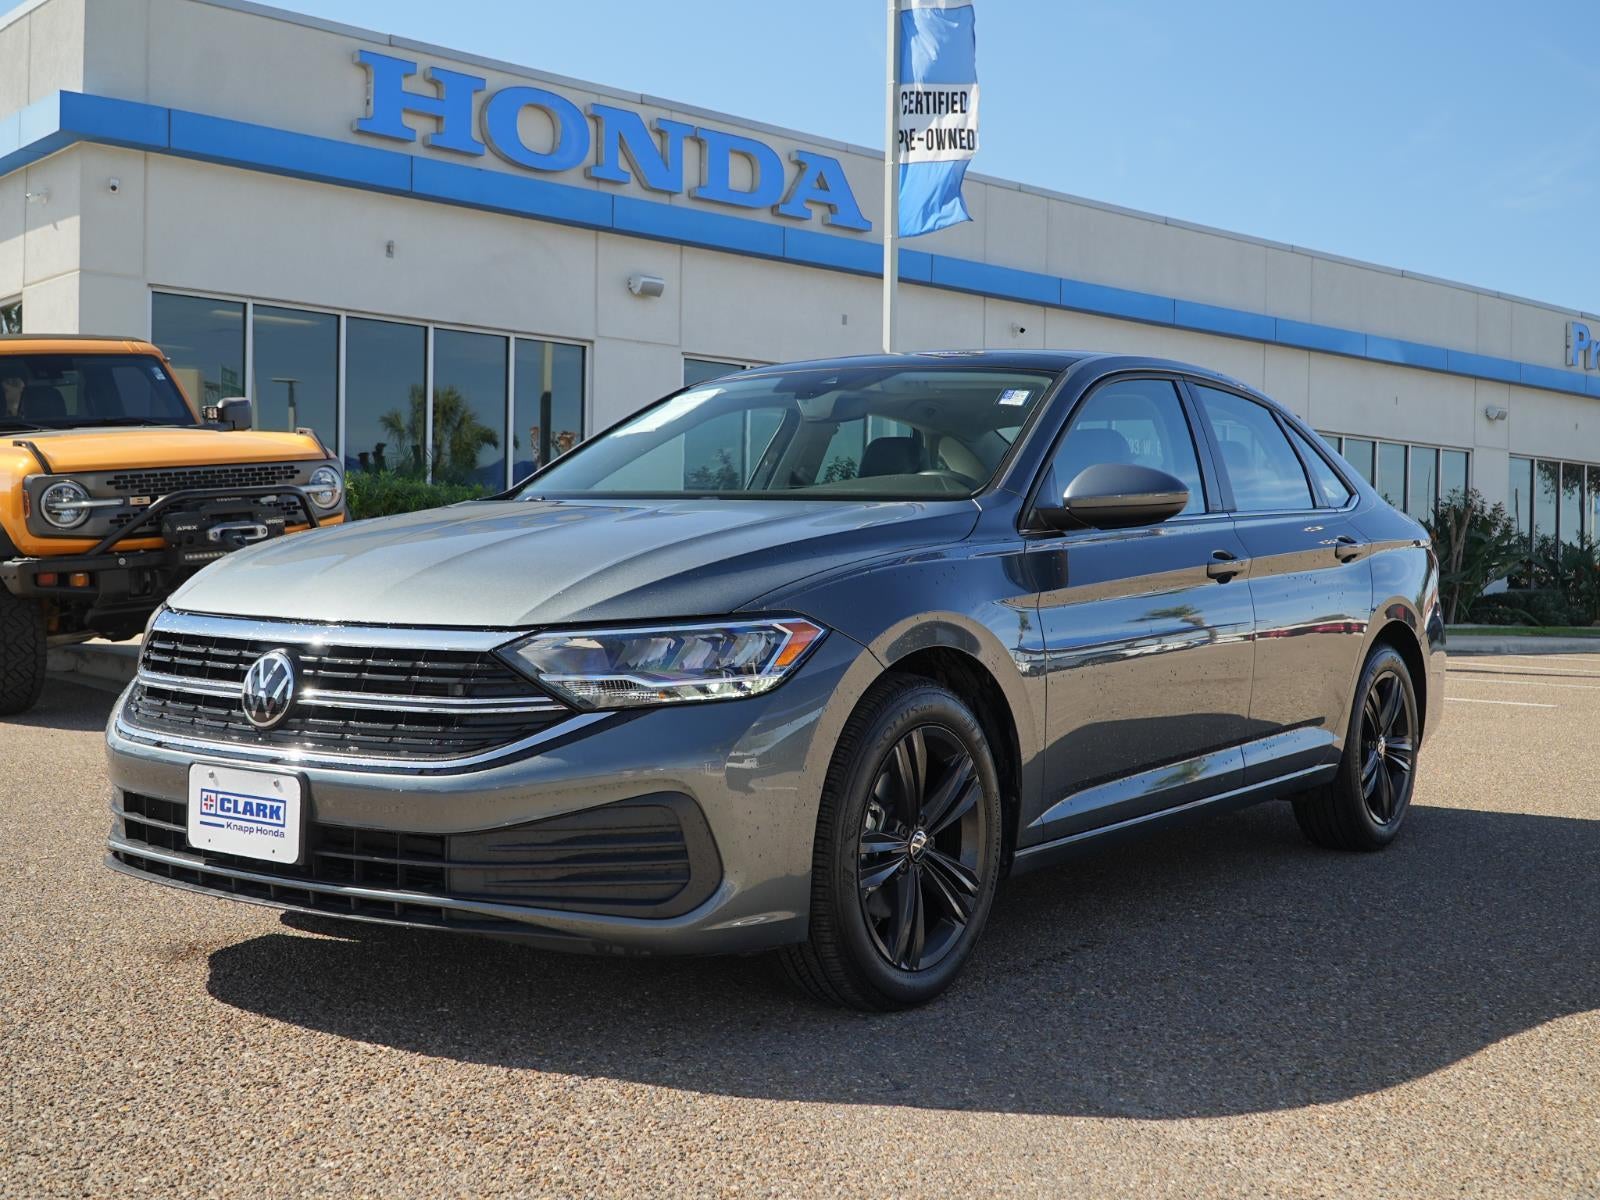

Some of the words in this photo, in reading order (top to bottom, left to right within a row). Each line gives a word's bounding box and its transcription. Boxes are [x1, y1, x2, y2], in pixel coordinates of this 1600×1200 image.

[901, 91, 968, 115] CERTIFIED
[353, 49, 873, 232] HONDA
[898, 128, 976, 152] PRE-OWNED
[219, 797, 282, 821] CLARK
[226, 821, 255, 834] Knapp
[256, 826, 285, 838] Honda
